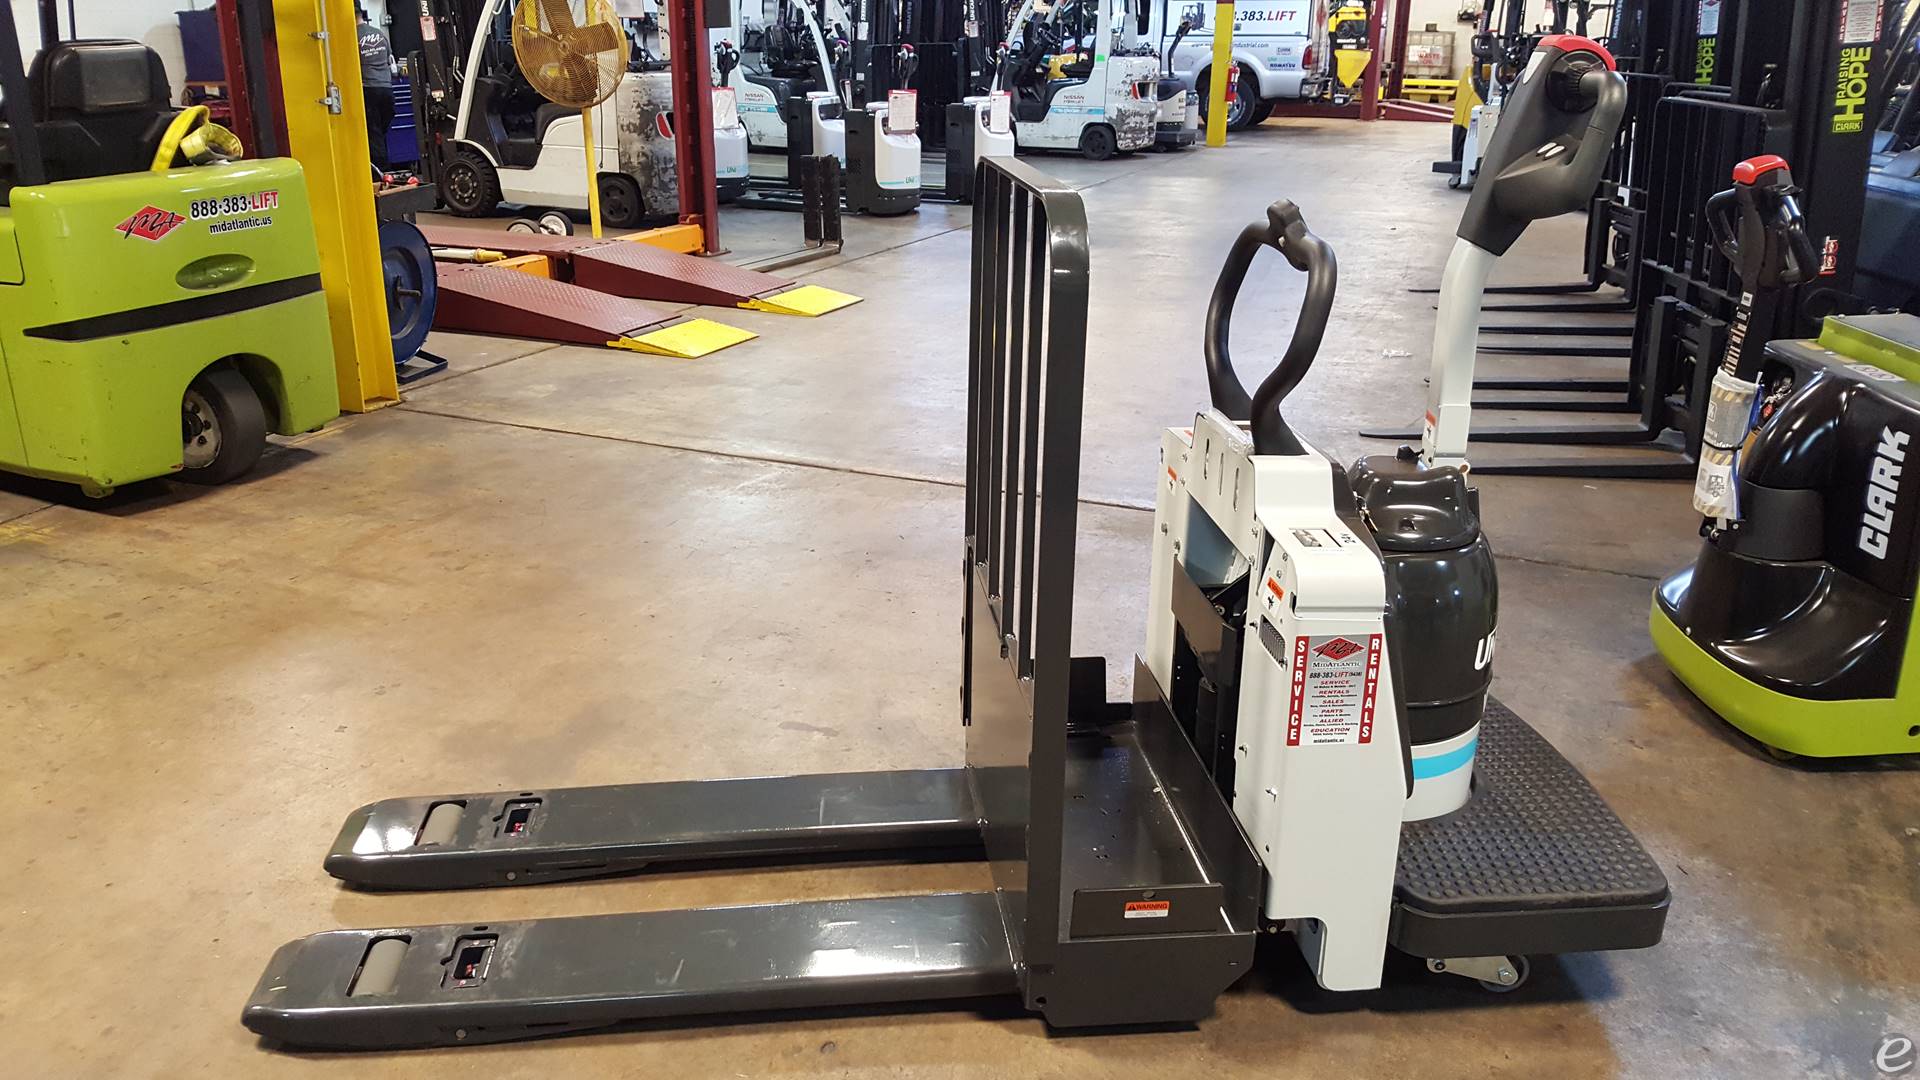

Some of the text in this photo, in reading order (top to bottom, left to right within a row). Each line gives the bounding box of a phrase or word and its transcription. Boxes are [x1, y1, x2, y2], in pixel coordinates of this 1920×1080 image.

[1695, 37, 1716, 86] HOPE
[1834, 47, 1872, 122] HOPE
[1837, 48, 1851, 98] RAISING
[1835, 121, 1861, 131] CLARK
[209, 216, 272, 234] midatlantic.us
[1859, 426, 1910, 559] CLARK
[1290, 640, 1306, 740] SERVICE
[1362, 638, 1380, 738] RENTALS
